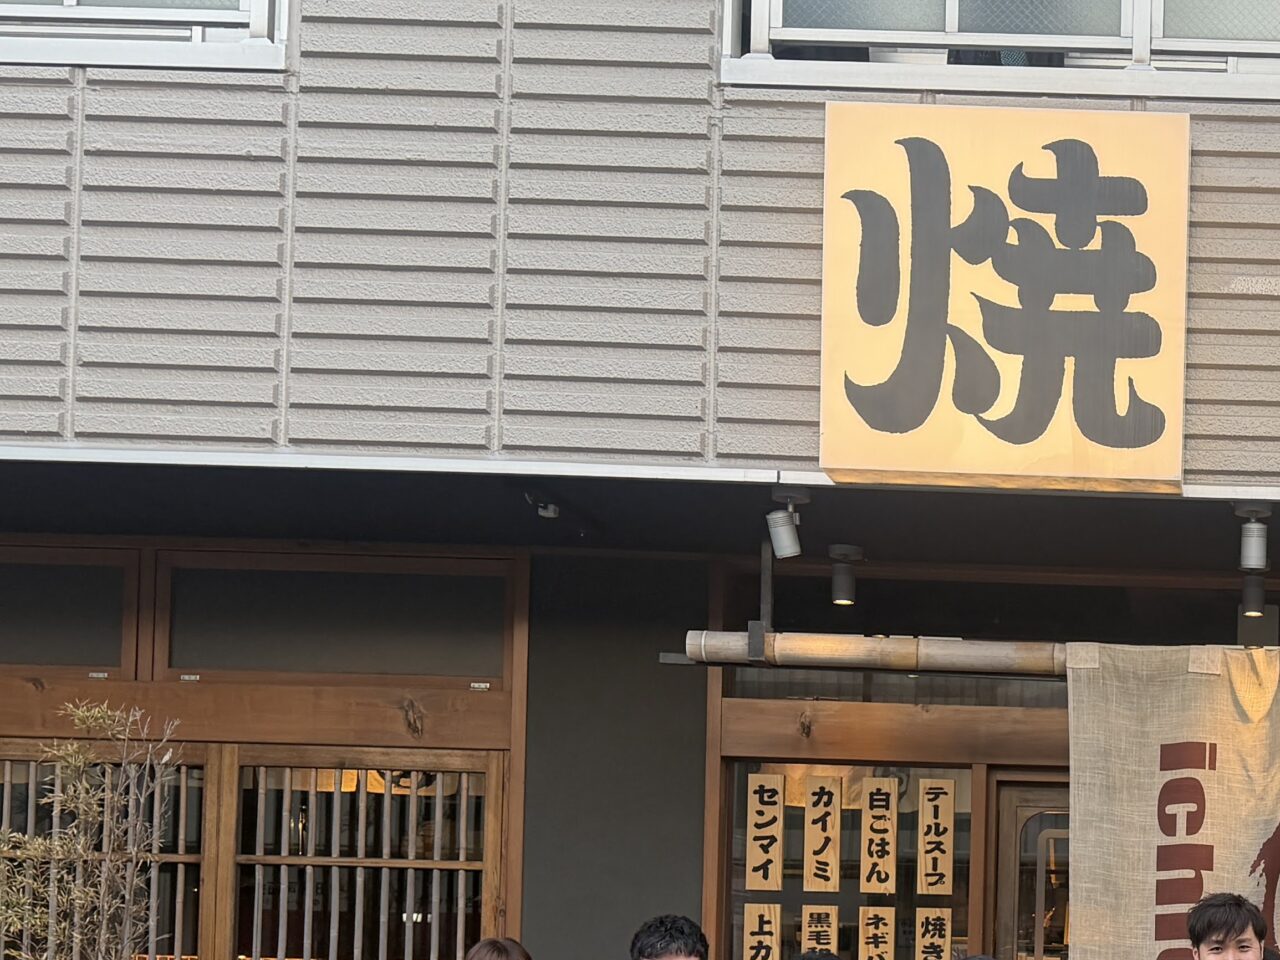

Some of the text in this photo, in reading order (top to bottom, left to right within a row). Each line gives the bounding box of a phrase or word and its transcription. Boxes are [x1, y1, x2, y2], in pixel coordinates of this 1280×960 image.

[752, 784, 779, 881] センマイ
[811, 786, 834, 882] カイノミ
[865, 788, 892, 884] 白ごはん
[923, 786, 949, 887] テールスープ
